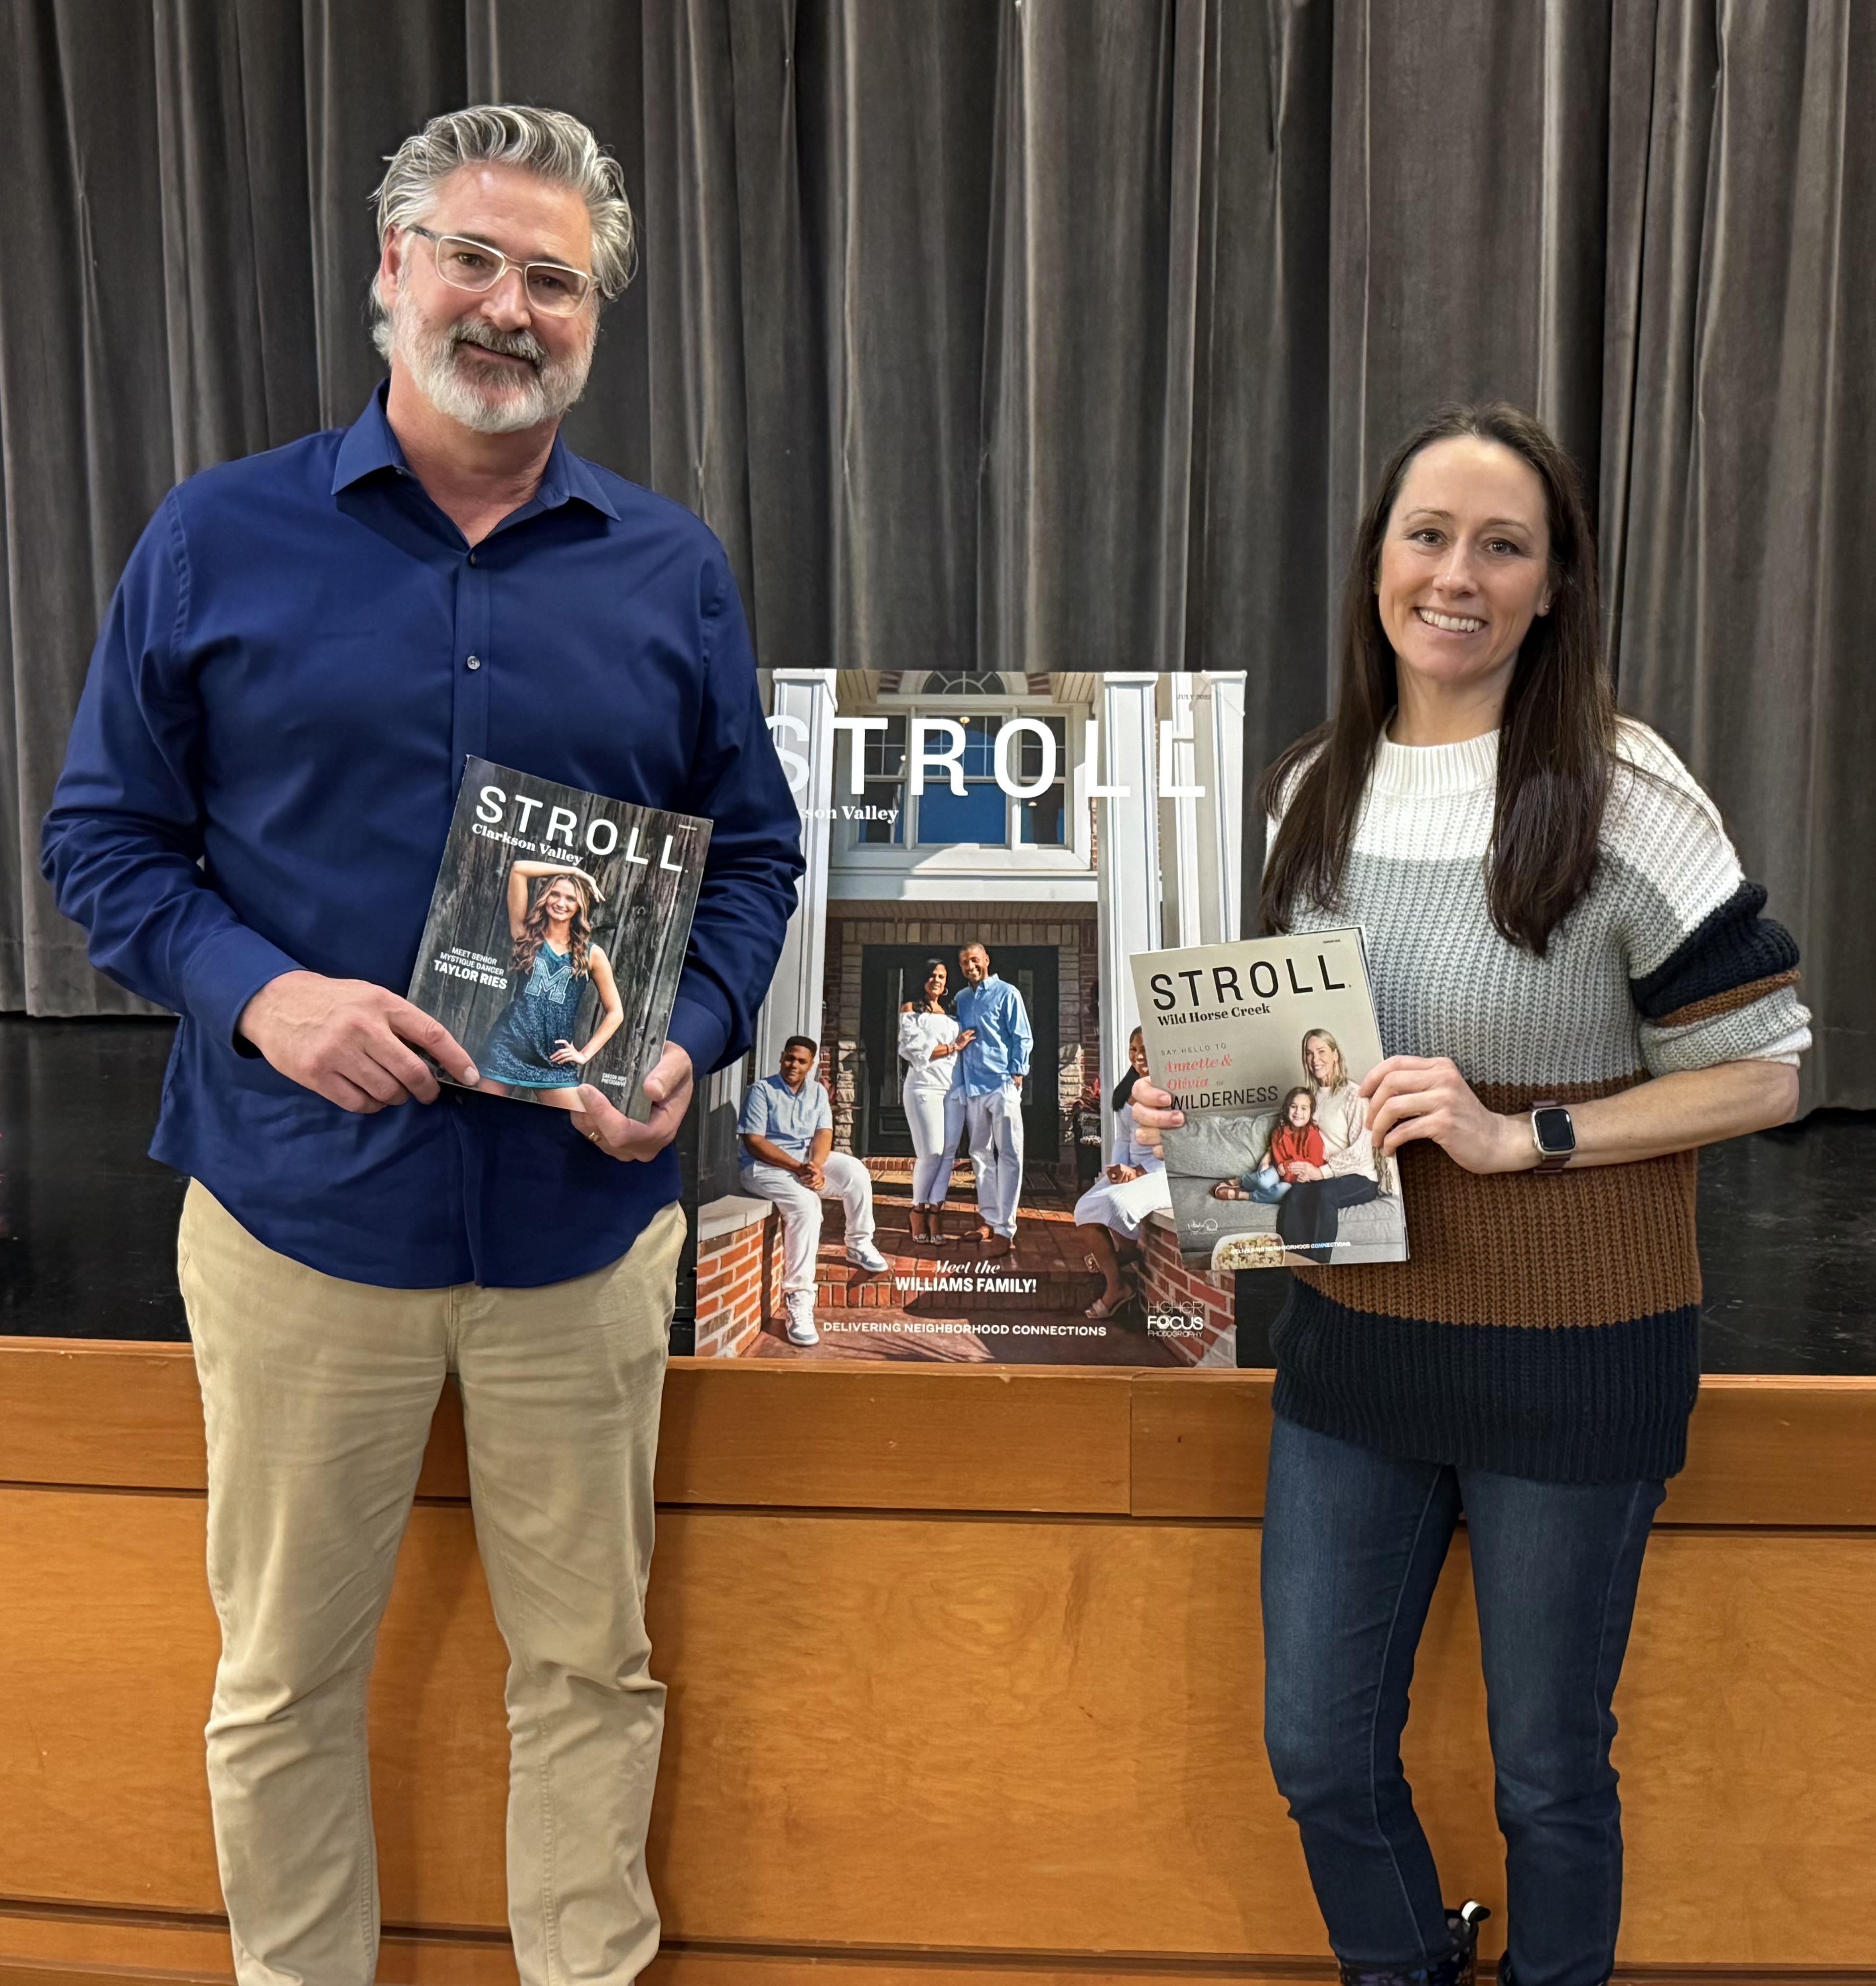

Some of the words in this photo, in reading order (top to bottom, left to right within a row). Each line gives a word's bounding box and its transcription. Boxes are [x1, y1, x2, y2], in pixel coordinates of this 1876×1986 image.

[765, 715, 1205, 798] STROLL
[841, 805, 899, 824] Valley
[476, 786, 682, 872] STROLL
[472, 823, 536, 852] Clarkson
[539, 842, 584, 866] Valley
[440, 952, 476, 968] MYSTIQUE
[476, 962, 505, 976] DANCER
[452, 947, 471, 958] MEET
[471, 953, 497, 966] SENIOR
[434, 959, 479, 982] TAYLOR
[480, 972, 508, 989] RIES
[1150, 955, 1346, 1010] STROLL
[1157, 1013, 1186, 1026] Wild
[1189, 1009, 1228, 1023] Horse
[1231, 1003, 1271, 1018] Creek
[1181, 1045, 1210, 1053] HELLO
[1164, 1057, 1218, 1073] Annette
[1167, 1077, 1209, 1090] Olivia
[1171, 1086, 1278, 1110] WILDERNESS
[933, 1260, 971, 1274] Meet
[974, 1260, 1000, 1274] the
[895, 1277, 973, 1292] WILLIAMS
[976, 1278, 1037, 1293] FAMILY!
[823, 1323, 901, 1332] DELIVERING
[904, 1324, 1009, 1335] NEIGHBORHOOD
[1012, 1325, 1107, 1336] CONNECTIONS
[1147, 1315, 1204, 1330] FOCUS
